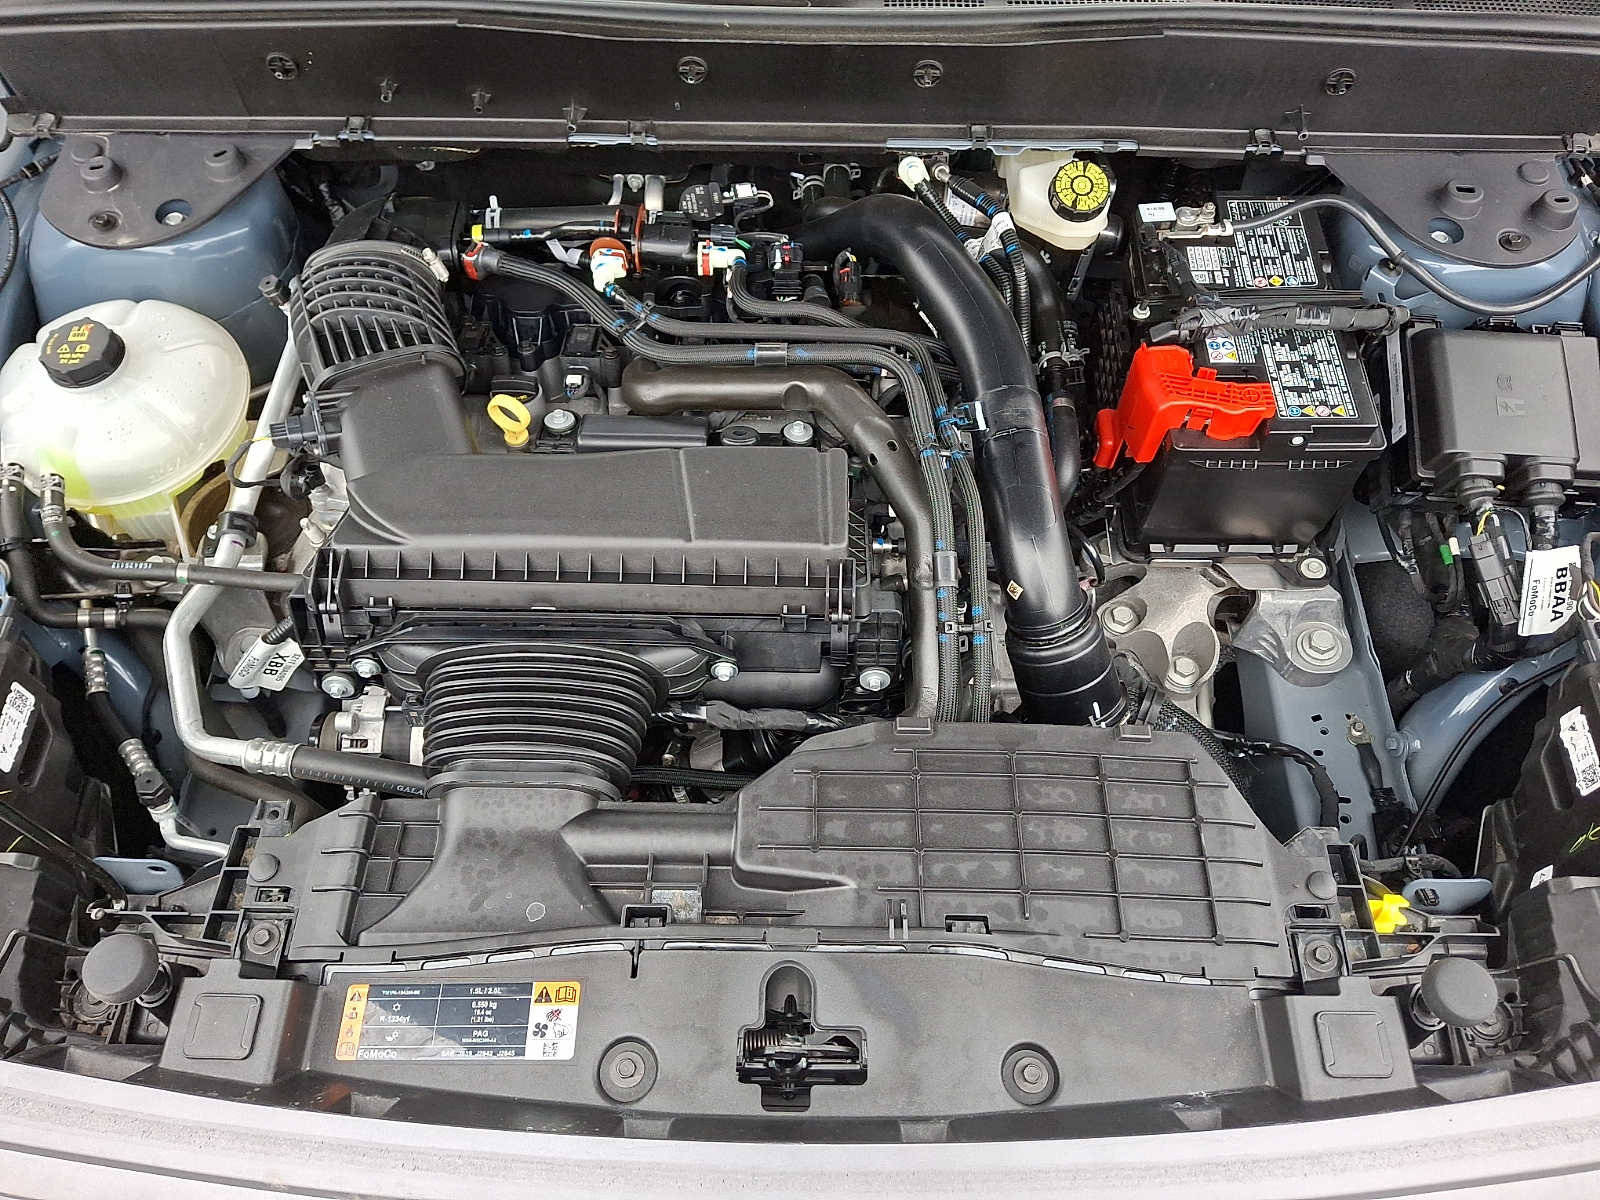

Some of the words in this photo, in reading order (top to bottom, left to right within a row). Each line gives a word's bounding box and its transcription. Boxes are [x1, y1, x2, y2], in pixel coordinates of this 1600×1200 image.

[1527, 579, 1541, 617] FoMoCo
[1549, 567, 1568, 623] BBAA
[262, 652, 290, 676] XBB
[469, 987, 483, 995] 1.5L
[488, 986, 502, 995] 2.0L
[489, 1000, 498, 1009] kg
[379, 1015, 411, 1024] R-1234yf
[472, 1030, 489, 1038] PAG
[357, 1049, 397, 1059] FoMoCo
